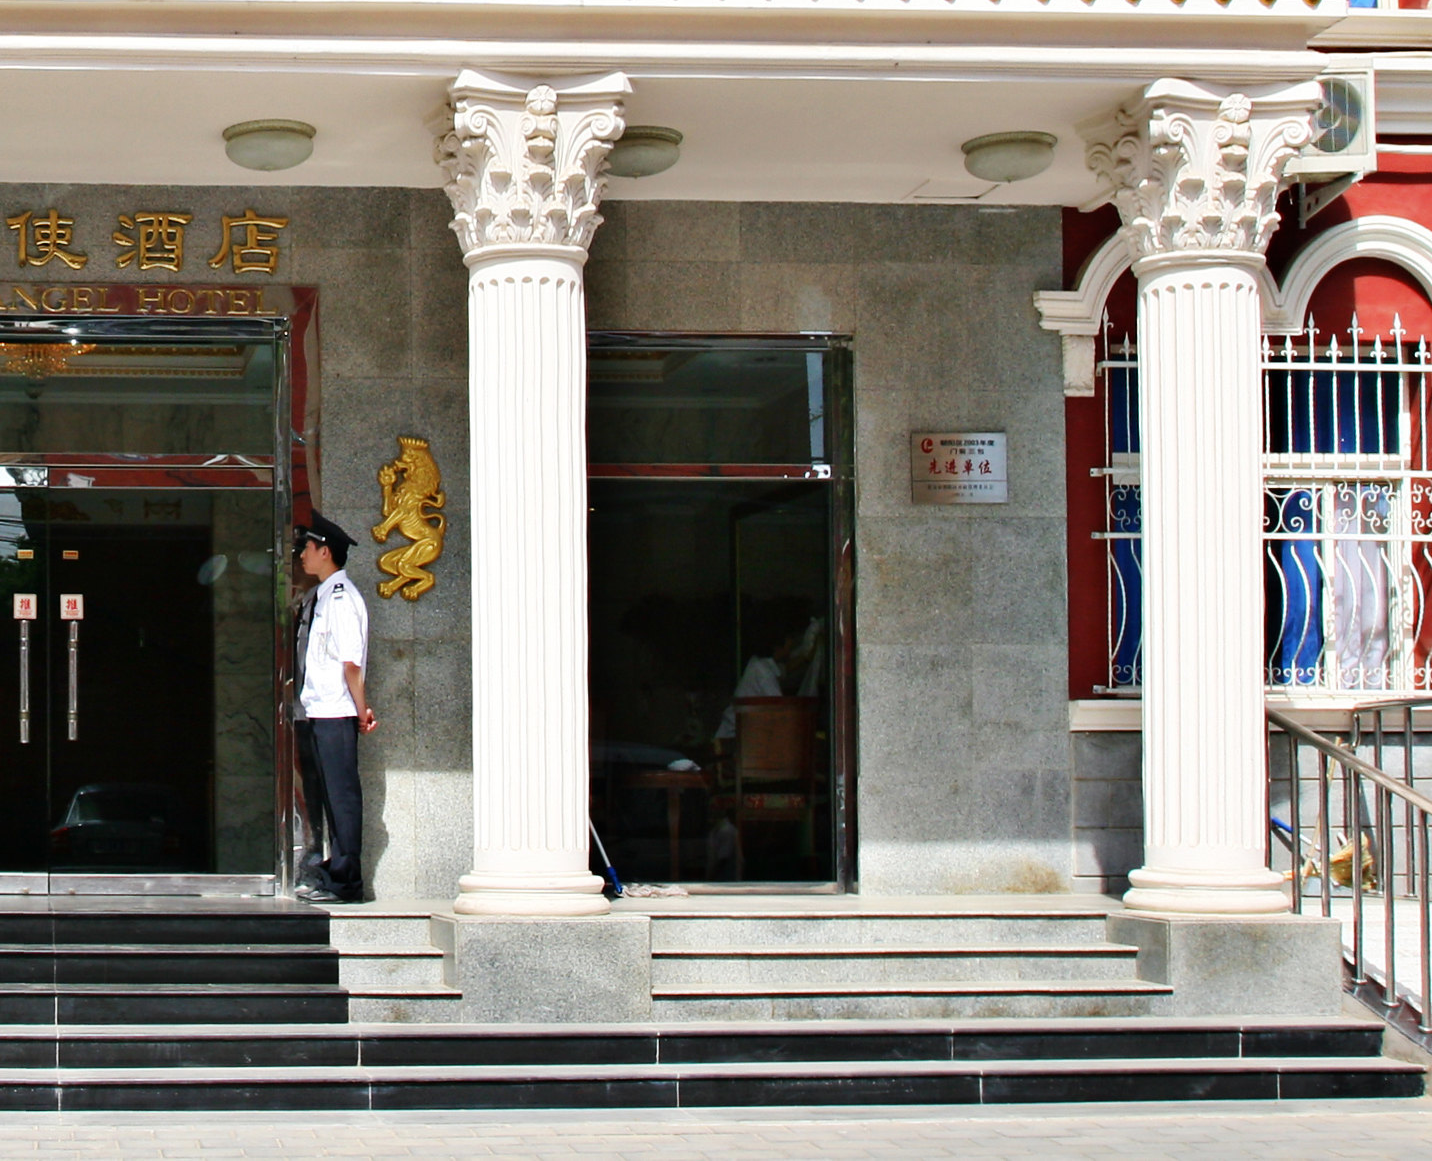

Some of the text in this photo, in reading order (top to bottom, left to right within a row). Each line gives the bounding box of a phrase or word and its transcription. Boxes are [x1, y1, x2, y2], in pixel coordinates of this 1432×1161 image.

[137, 287, 280, 315] HOTEL
[928, 458, 993, 476] 先进单位
